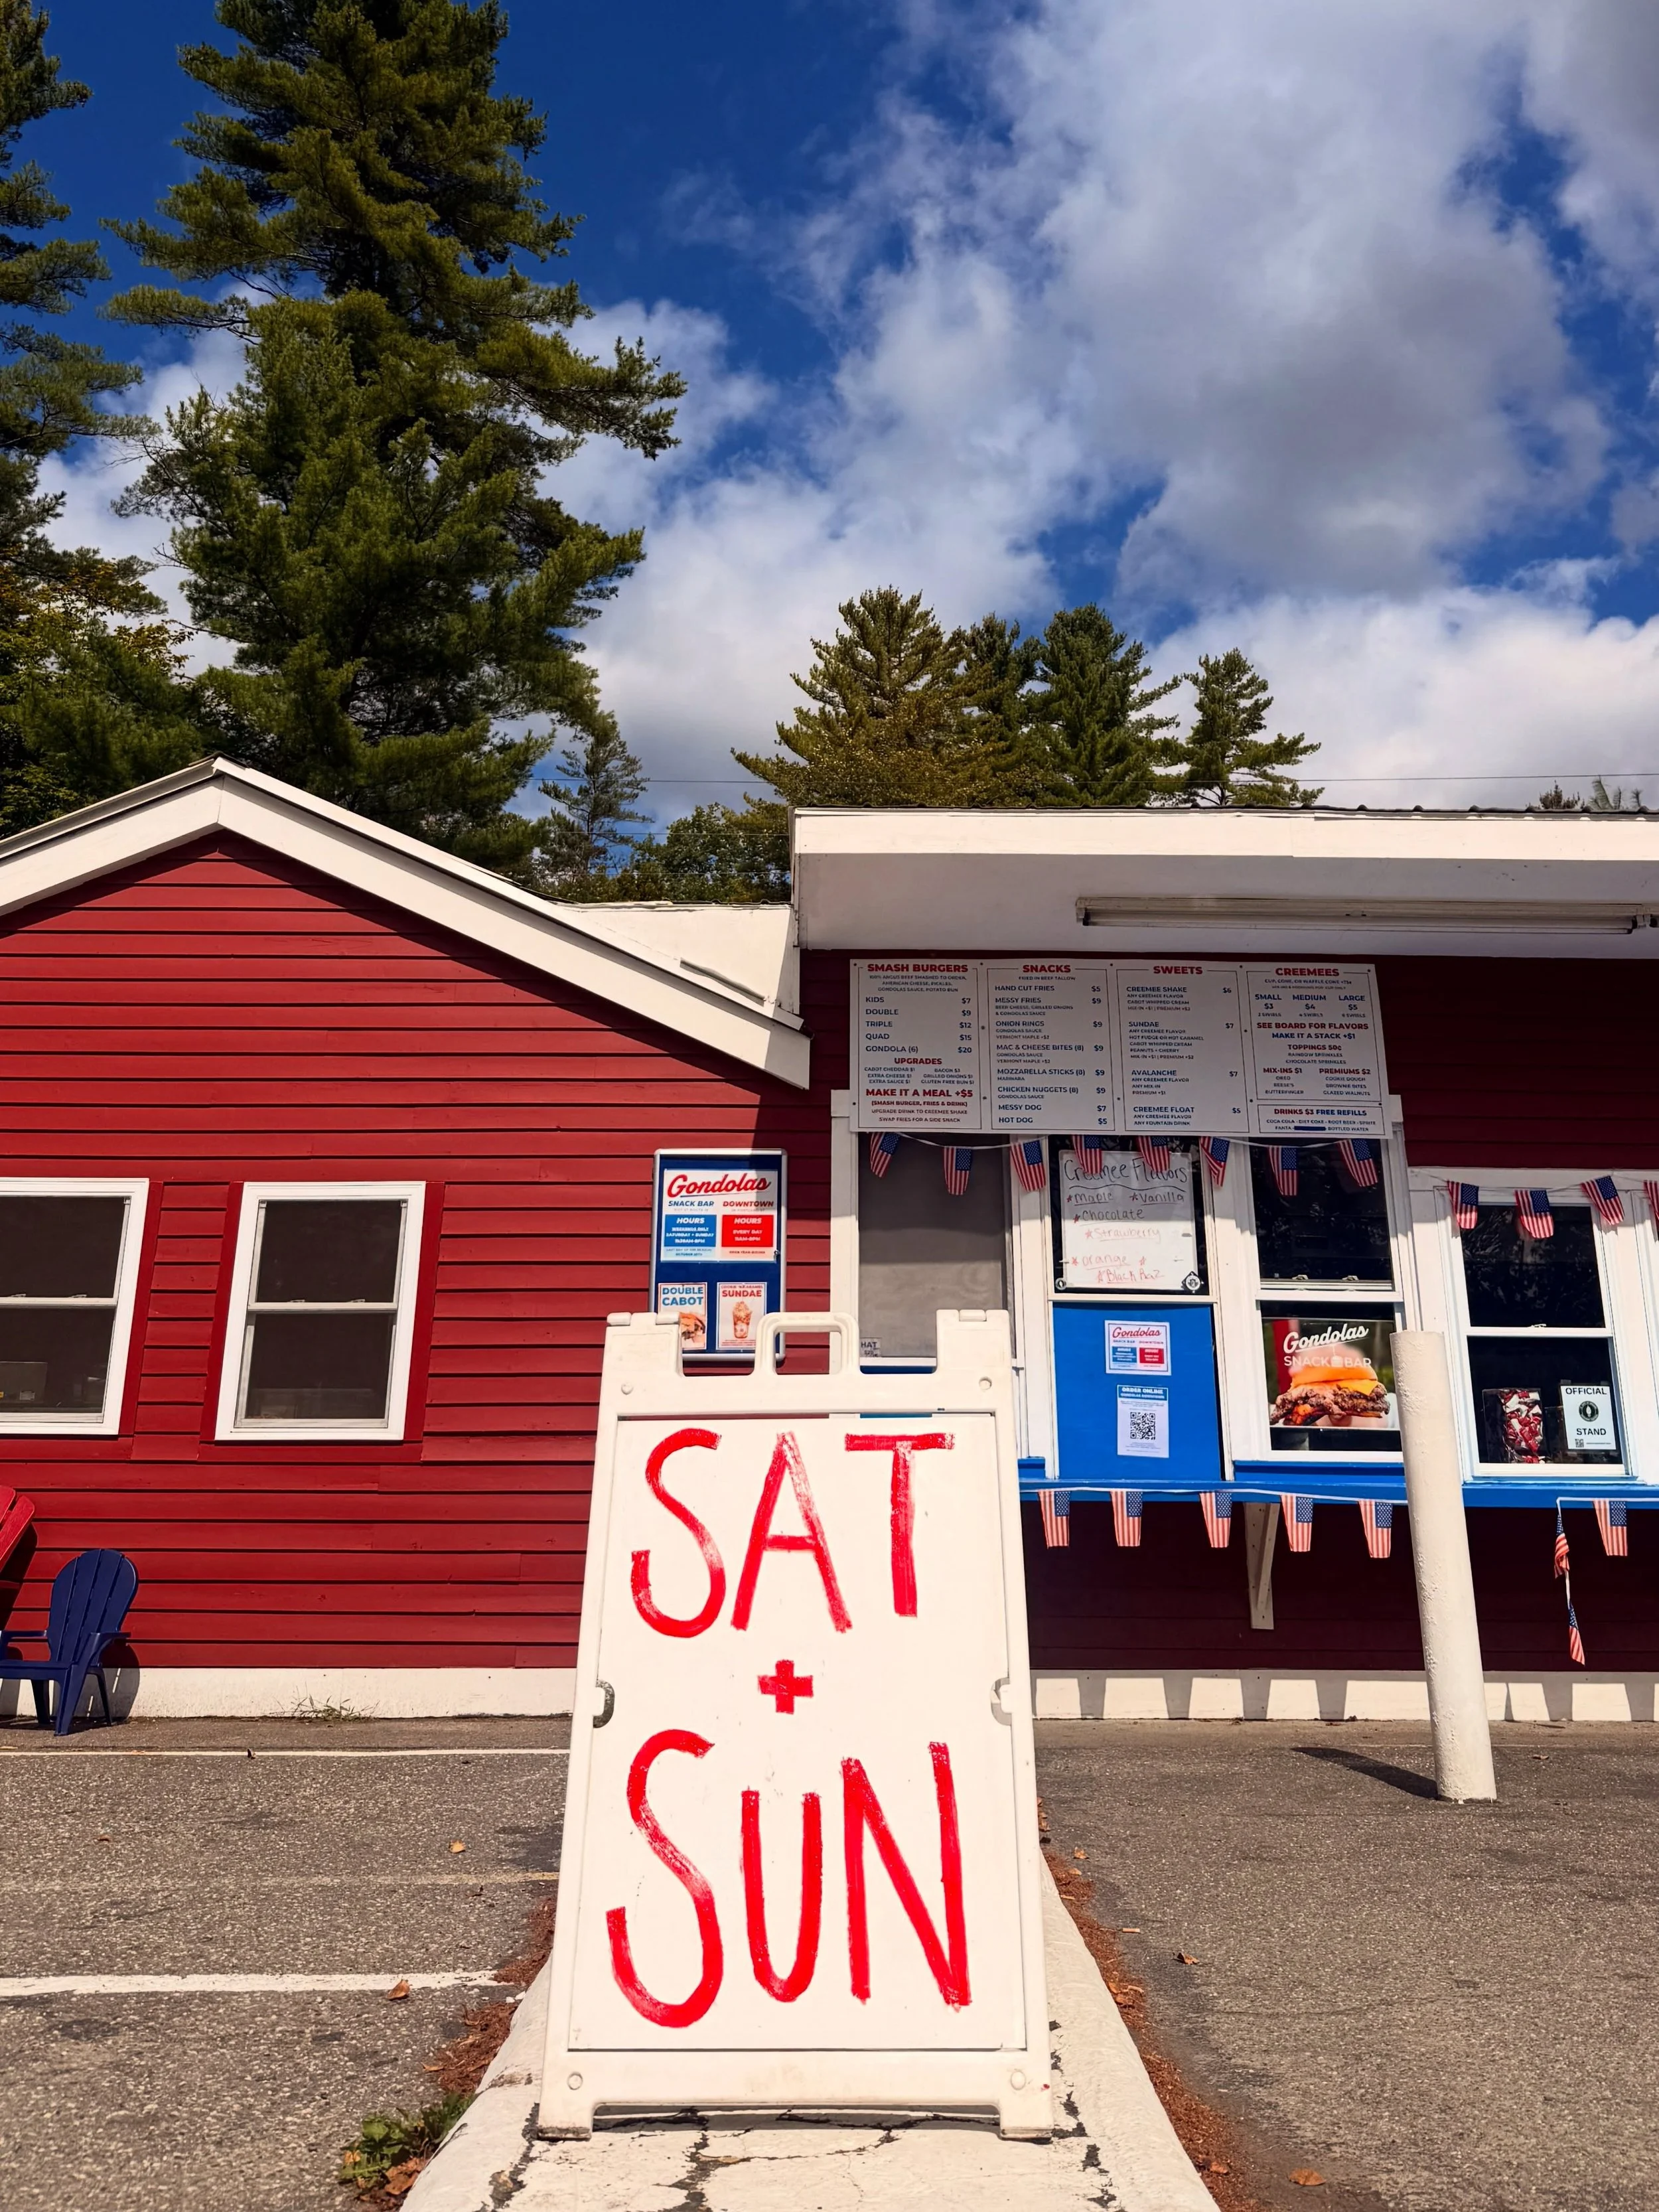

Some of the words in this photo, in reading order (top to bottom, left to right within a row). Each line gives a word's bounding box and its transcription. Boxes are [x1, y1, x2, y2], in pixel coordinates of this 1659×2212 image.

[668, 1173, 771, 1198] Gondolas
[1139, 1192, 1184, 1203] Vanilla
[1082, 1209, 1145, 1220] Chocolate
[1095, 1228, 1160, 1242] Strawberry
[662, 1297, 703, 1305] CABOT
[1112, 1327, 1161, 1338] Gondolas
[1283, 1323, 1369, 1353] Gondolas
[1284, 1356, 1329, 1366] SNACK
[1345, 1358, 1372, 1367] BAR
[630, 1427, 954, 1638] SAT
[757, 1659, 814, 1715] +
[607, 1728, 972, 2029] SUN
